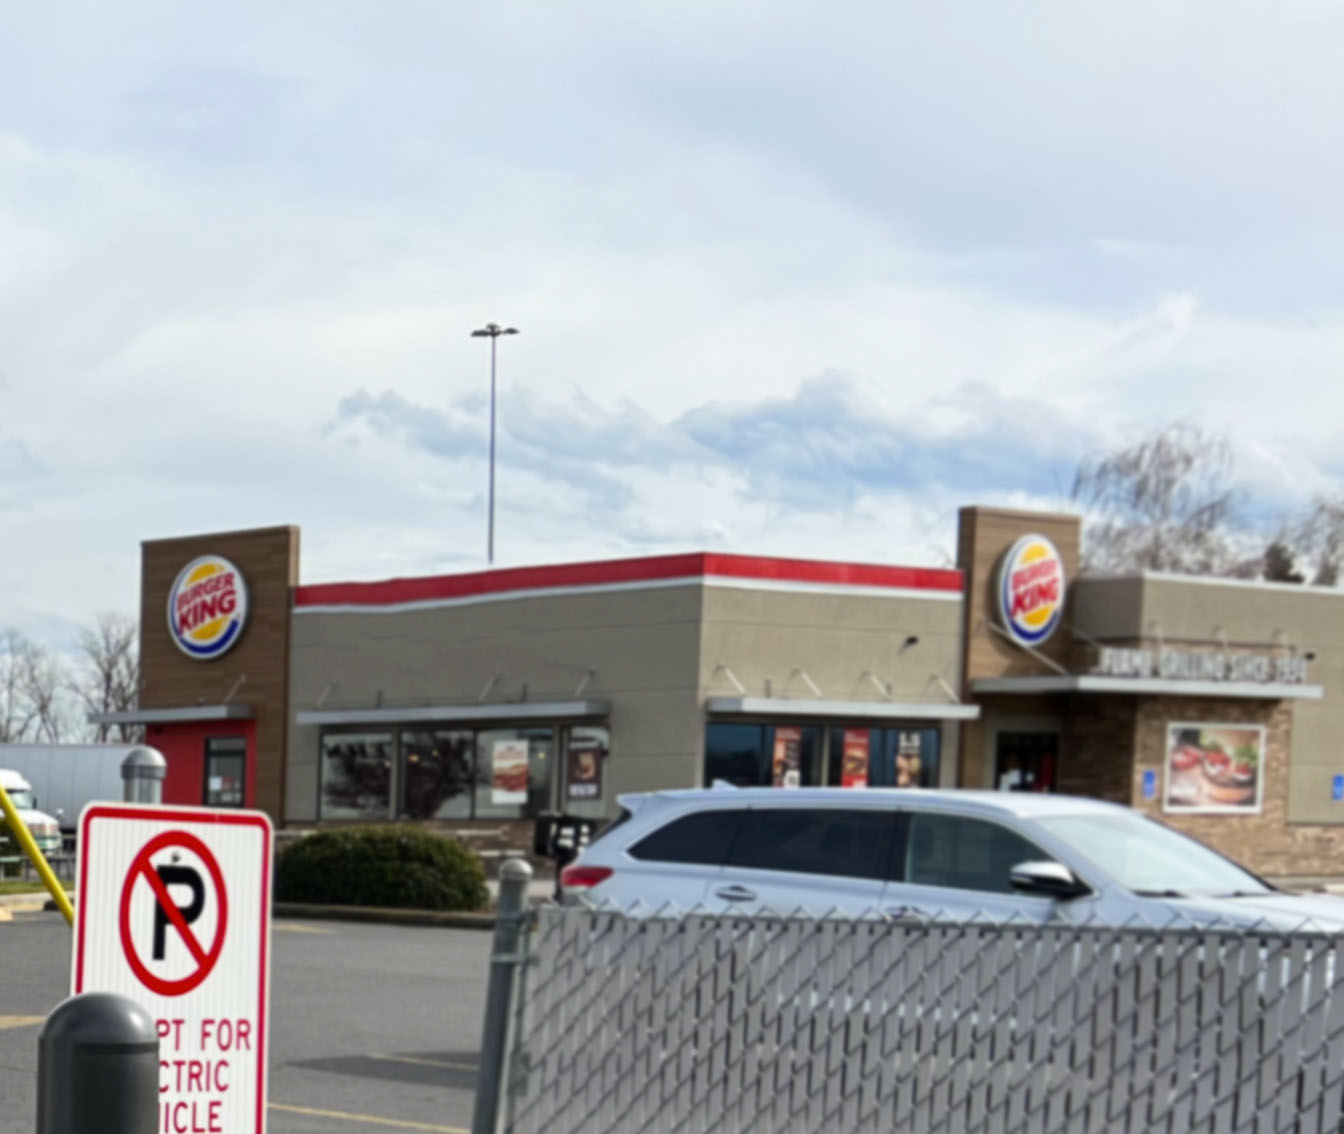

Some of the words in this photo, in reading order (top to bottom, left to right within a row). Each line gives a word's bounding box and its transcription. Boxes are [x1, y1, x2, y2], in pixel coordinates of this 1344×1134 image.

[179, 589, 236, 636] KING
[201, 1018, 251, 1051] FOR
[158, 1059, 229, 1093] CTRIC
[158, 1101, 222, 1134] ICLE
